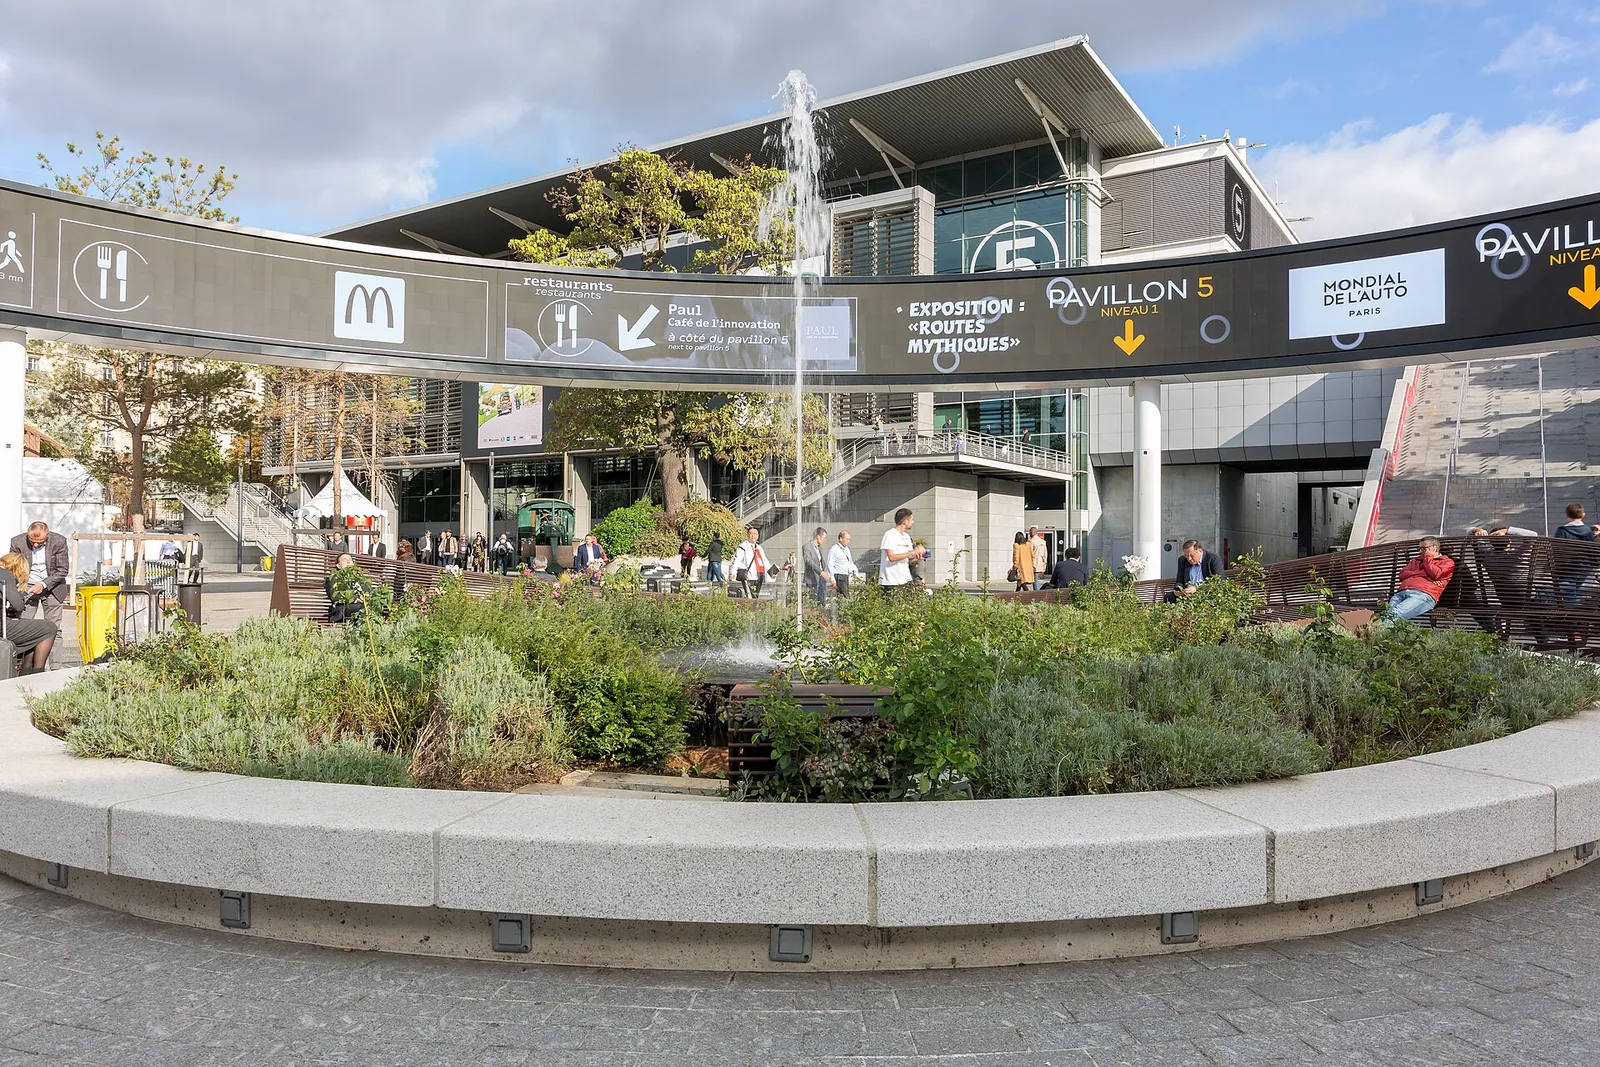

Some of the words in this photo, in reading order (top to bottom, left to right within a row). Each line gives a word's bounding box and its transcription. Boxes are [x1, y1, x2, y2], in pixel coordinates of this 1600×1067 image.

[1235, 192, 1243, 233] 5
[1480, 220, 1600, 262] PAVILL
[523, 277, 614, 292] restaurants
[1323, 272, 1407, 293] MONDIAL
[534, 288, 602, 300] restaurants
[1049, 278, 1188, 309] PAVILLON
[1197, 276, 1214, 298] 5
[1323, 293, 1344, 306] DE
[668, 304, 703, 316] Paul
[909, 299, 1013, 317] EXPOSITION
[1101, 305, 1149, 317] NIVEAU
[1152, 304, 1159, 314] 1
[1349, 307, 1381, 317] PARIS
[668, 318, 693, 327] Café
[696, 319, 709, 328] de
[908, 319, 985, 335] «ROUTES
[807, 326, 839, 335] PAUL
[668, 333, 676, 342] à
[679, 333, 706, 343] côté
[709, 334, 724, 343] du
[727, 335, 777, 345] pavillon
[781, 336, 789, 344] 5
[907, 336, 1021, 353] MYTHIQUES»
